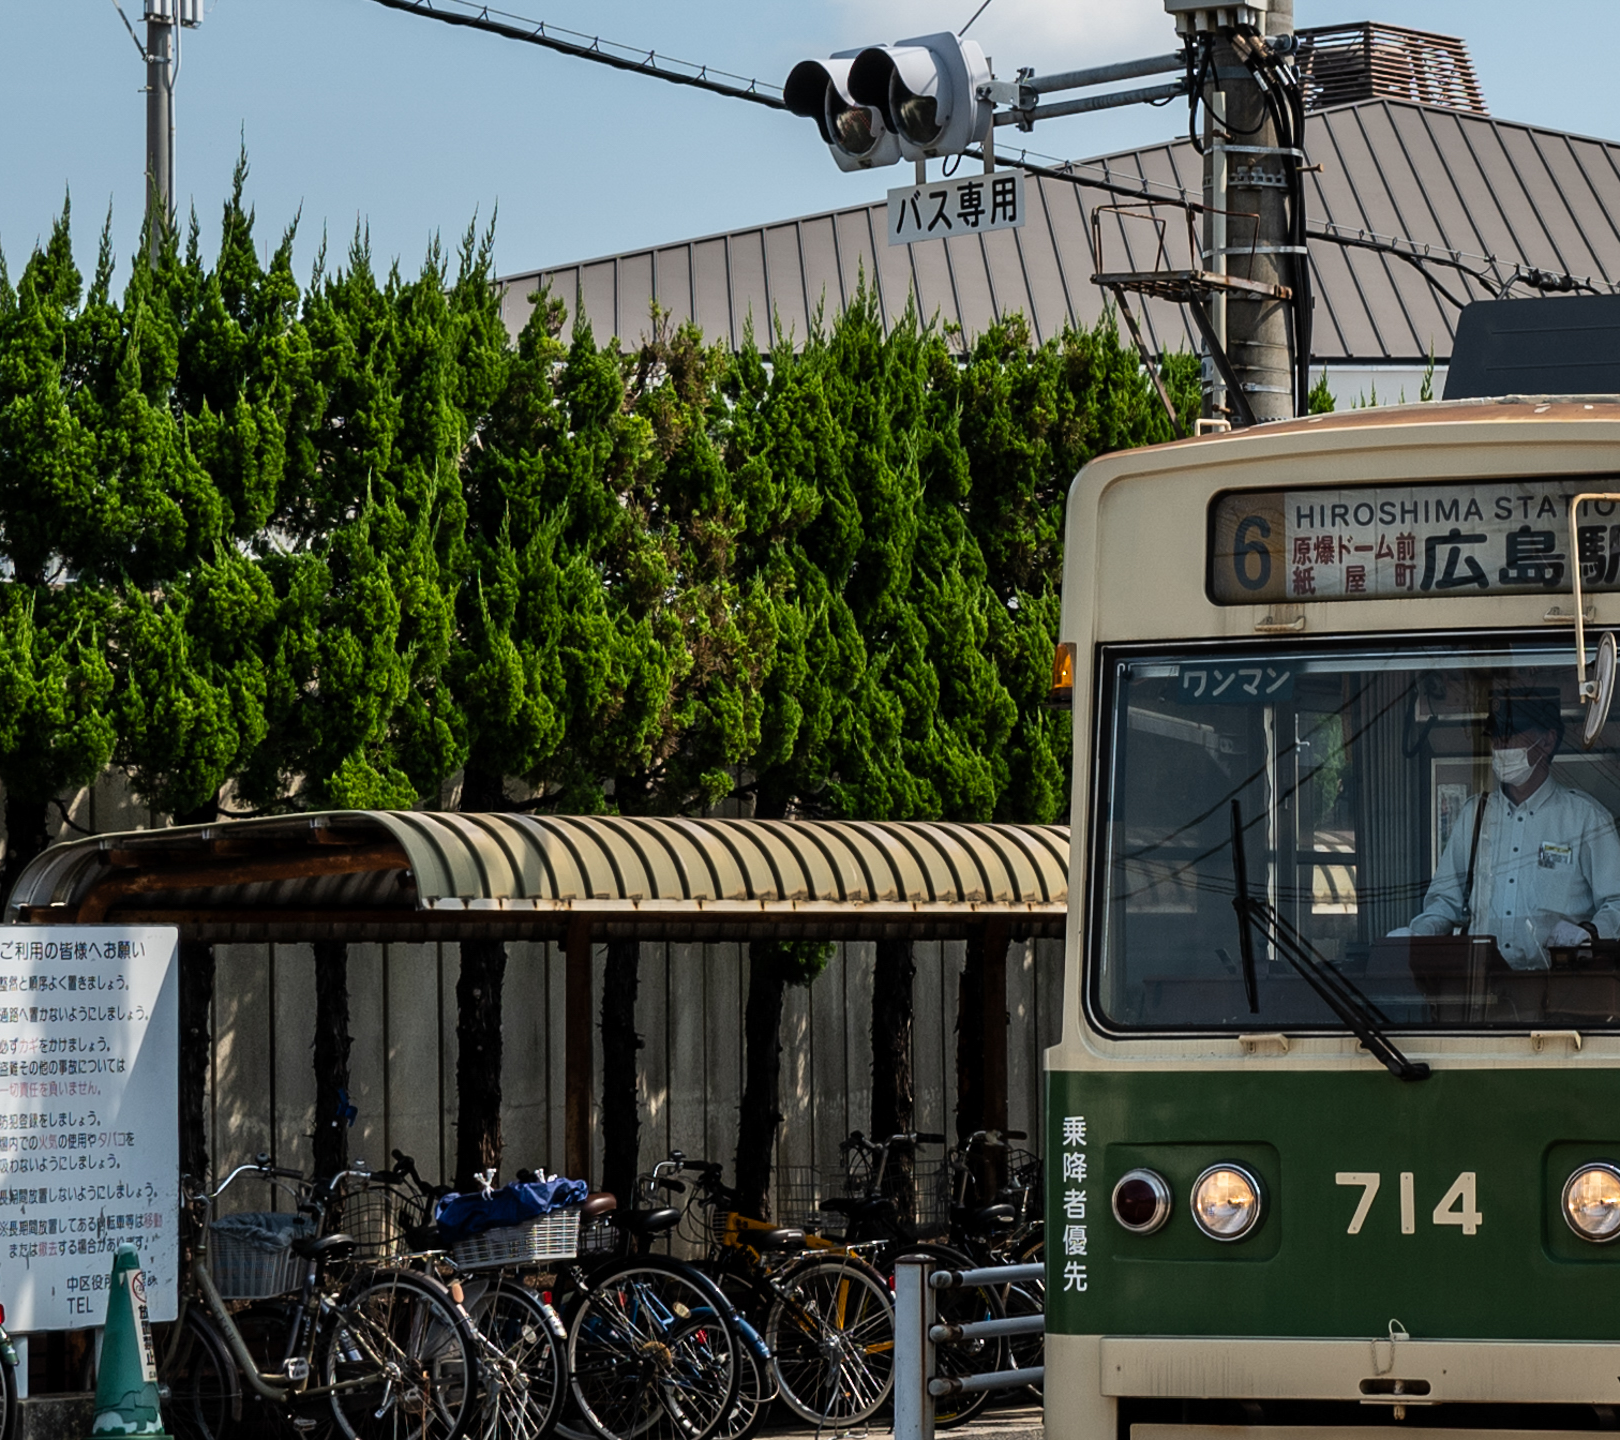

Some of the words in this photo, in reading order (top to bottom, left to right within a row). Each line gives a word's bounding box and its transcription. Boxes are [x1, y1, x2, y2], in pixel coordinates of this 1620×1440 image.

[895, 174, 1018, 235] バス専用
[1295, 498, 1484, 529] HIROSHIMA
[1233, 515, 1272, 591] 6
[1292, 531, 1416, 566] 原爆ドーム前
[1292, 563, 1416, 596] 紙屋町
[1183, 667, 1291, 698] ワンマン
[0, 940, 146, 961] ご利用の皆様へお願い
[0, 1006, 149, 1023] 通路へ置かないようにしましょう。
[0, 1036, 111, 1055] 必ずカギをかけましょう。
[0, 1058, 126, 1077] 盗難その他の事故については
[0, 1081, 102, 1099] 一切責任を負いません。
[0, 1111, 101, 1130] 防犯登録をしましょう。
[0, 1154, 121, 1174] 吸わないようにしましょう。
[0, 1182, 158, 1206] 長期間放置しないようにしましょう。
[1062, 1115, 1088, 1292] 乗降者優先
[1335, 1171, 1483, 1236] 714
[66, 1297, 94, 1315] TEL
